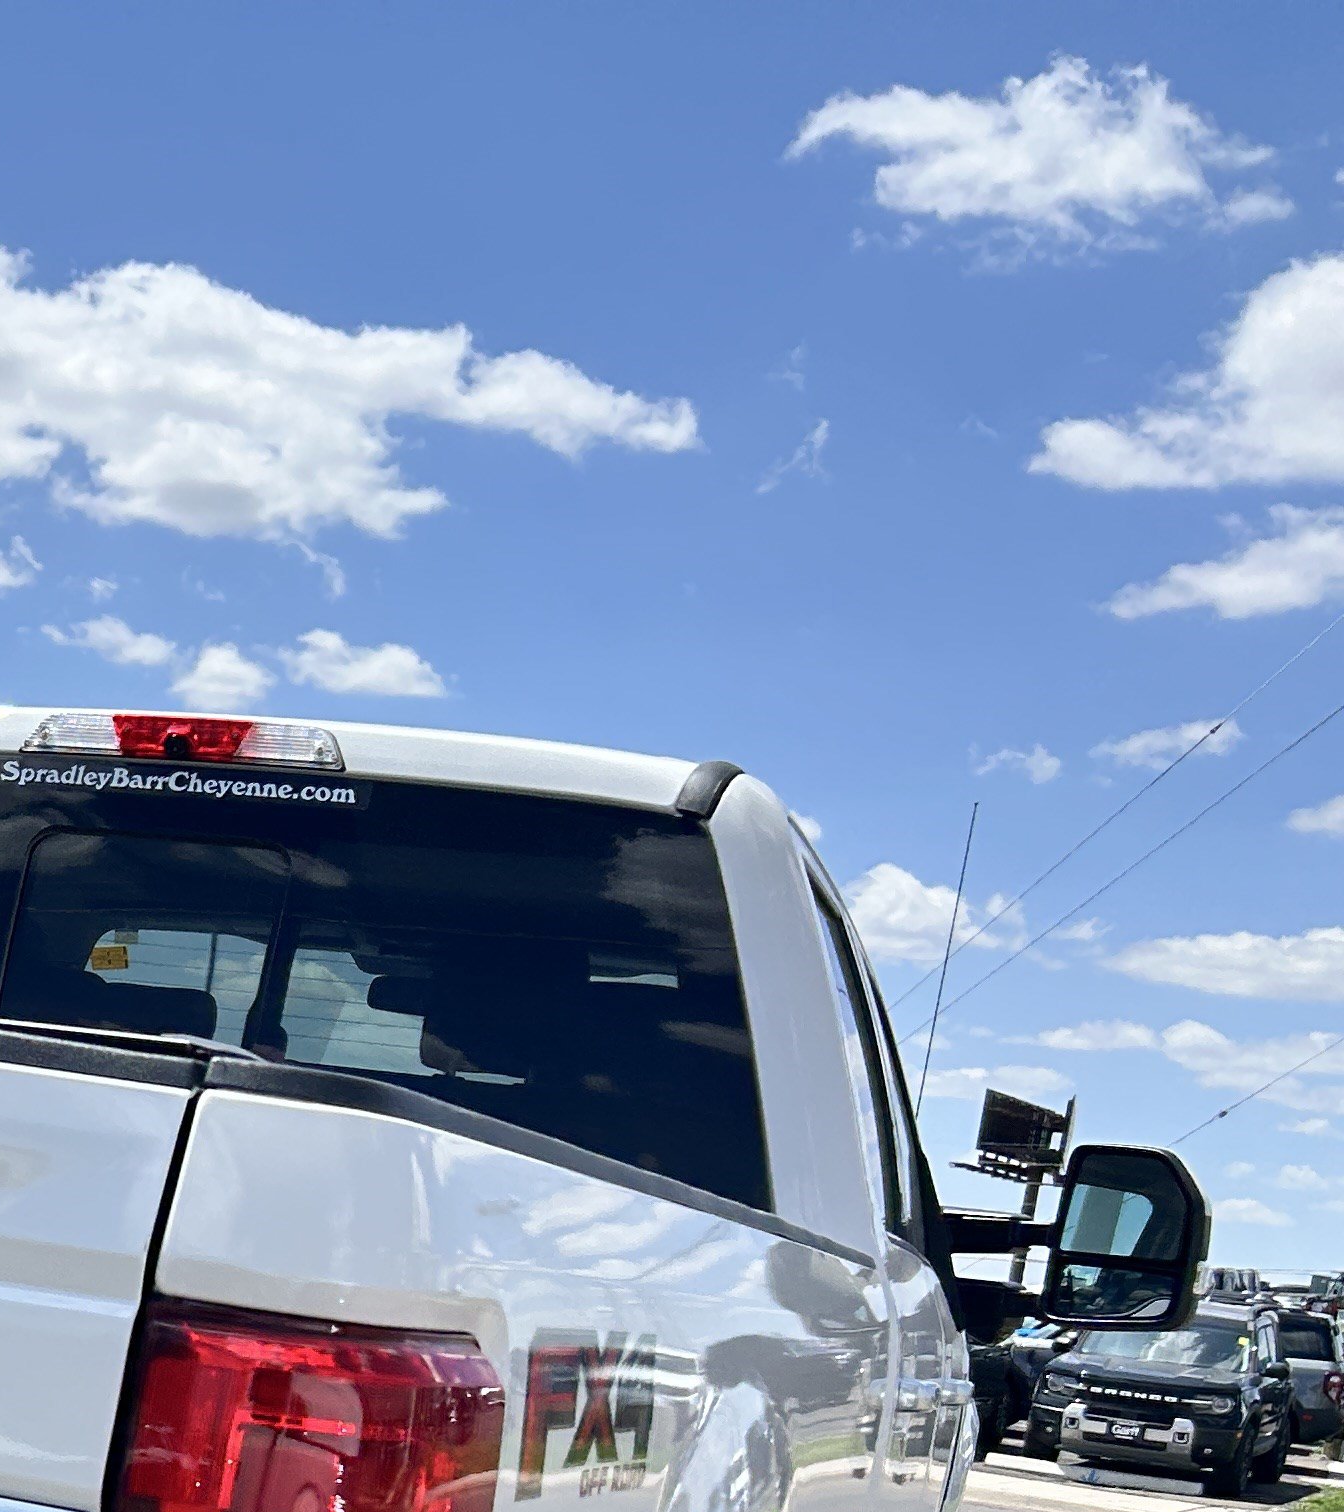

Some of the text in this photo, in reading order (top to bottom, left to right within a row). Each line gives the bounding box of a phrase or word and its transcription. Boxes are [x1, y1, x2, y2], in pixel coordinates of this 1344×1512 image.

[0, 760, 356, 805] SpradleyBarrCheyenne.com
[514, 1327, 657, 1502] FX4
[1090, 1386, 1178, 1403] BRONCO
